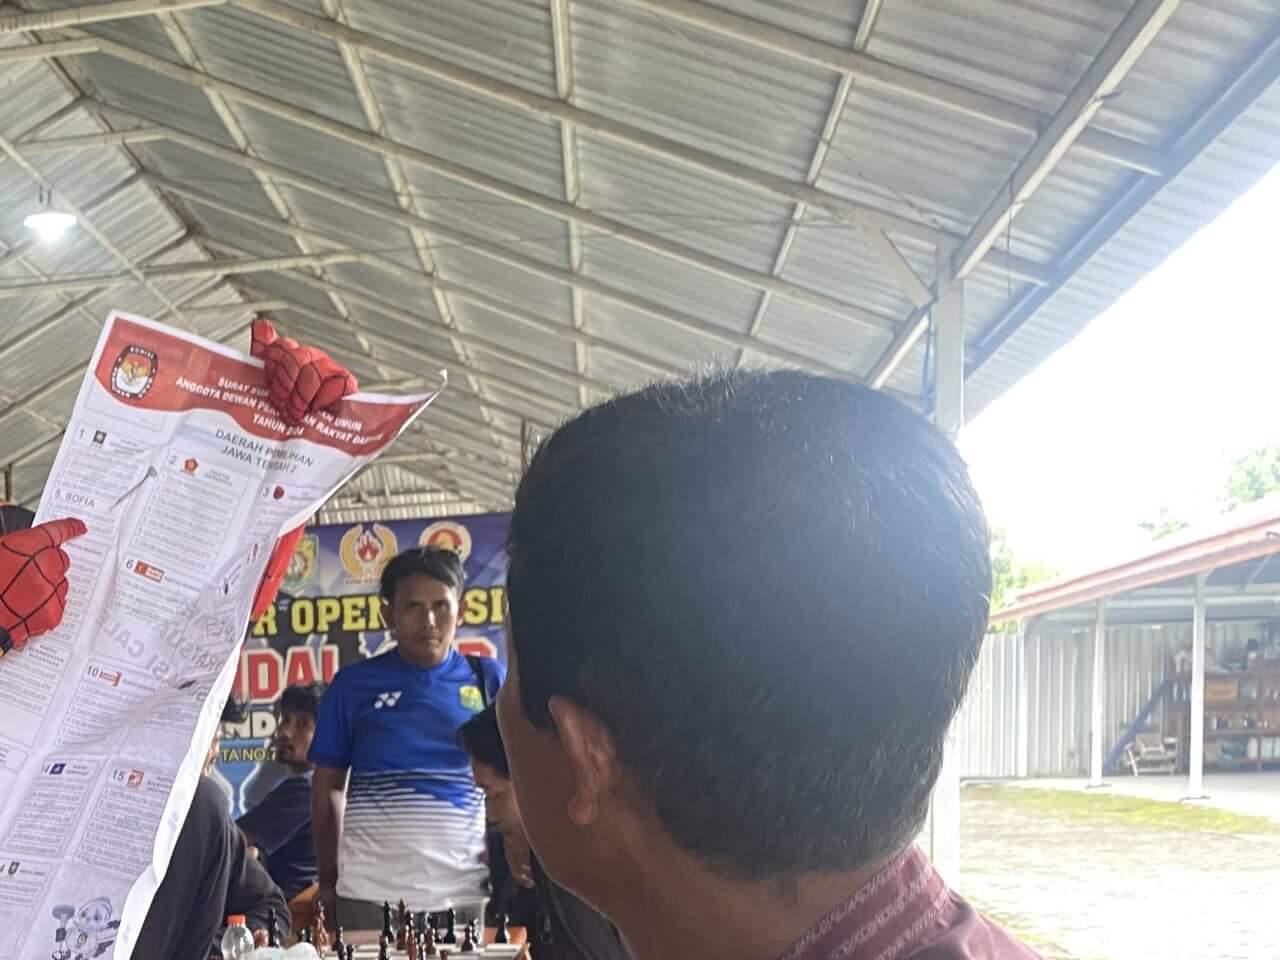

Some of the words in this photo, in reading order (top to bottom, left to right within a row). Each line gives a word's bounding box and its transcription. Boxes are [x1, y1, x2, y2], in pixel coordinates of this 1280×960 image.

[218, 376, 250, 393] SURAT
[176, 376, 221, 400] ANGGOTA
[222, 391, 257, 409] DEWAN
[315, 419, 353, 442] RAKYAT
[252, 413, 286, 434] TAHUN
[334, 416, 362, 431] UMUM
[215, 428, 264, 454] DAERAH
[221, 445, 252, 464] JAWA
[126, 559, 134, 569] 6
[87, 665, 100, 678] 10
[112, 769, 125, 781] 15
